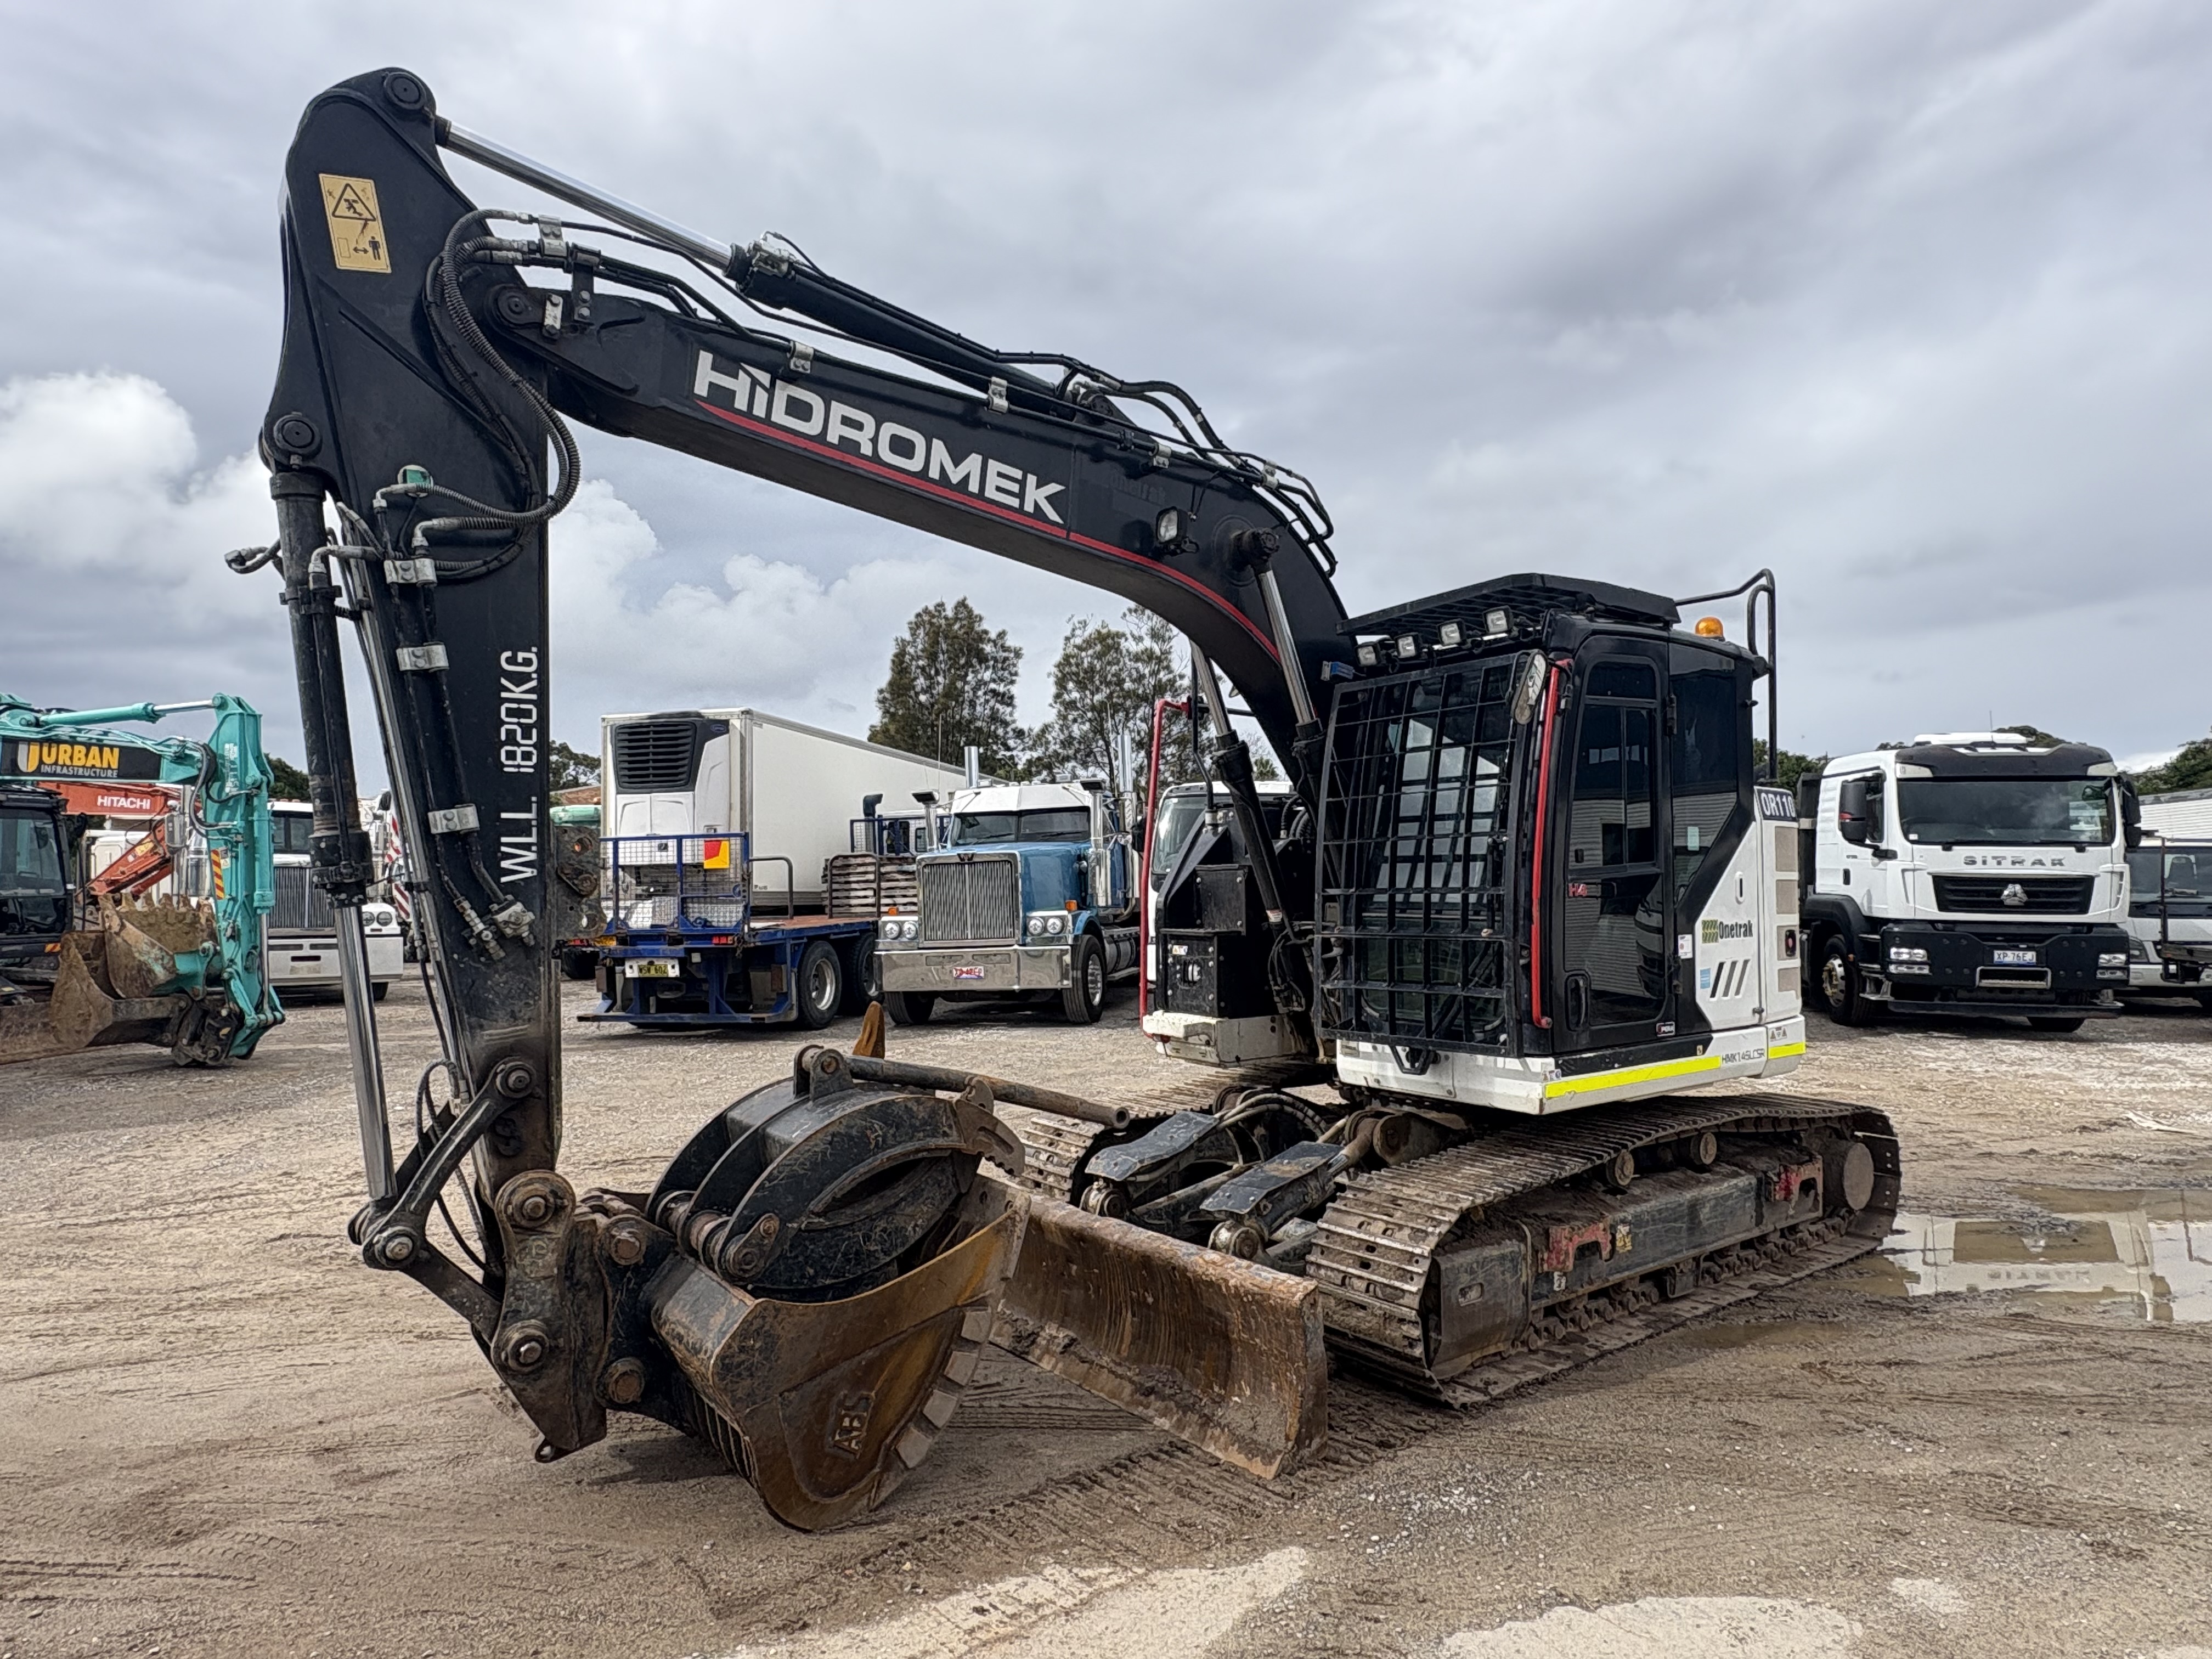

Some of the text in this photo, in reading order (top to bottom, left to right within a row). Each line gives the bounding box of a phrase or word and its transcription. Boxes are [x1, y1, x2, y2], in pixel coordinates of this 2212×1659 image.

[42, 742, 120, 769] URBAN
[41, 764, 118, 778] INFRASTRUCTURE
[97, 795, 151, 810] HITACHI
[1718, 919, 1753, 939] Onetrak
